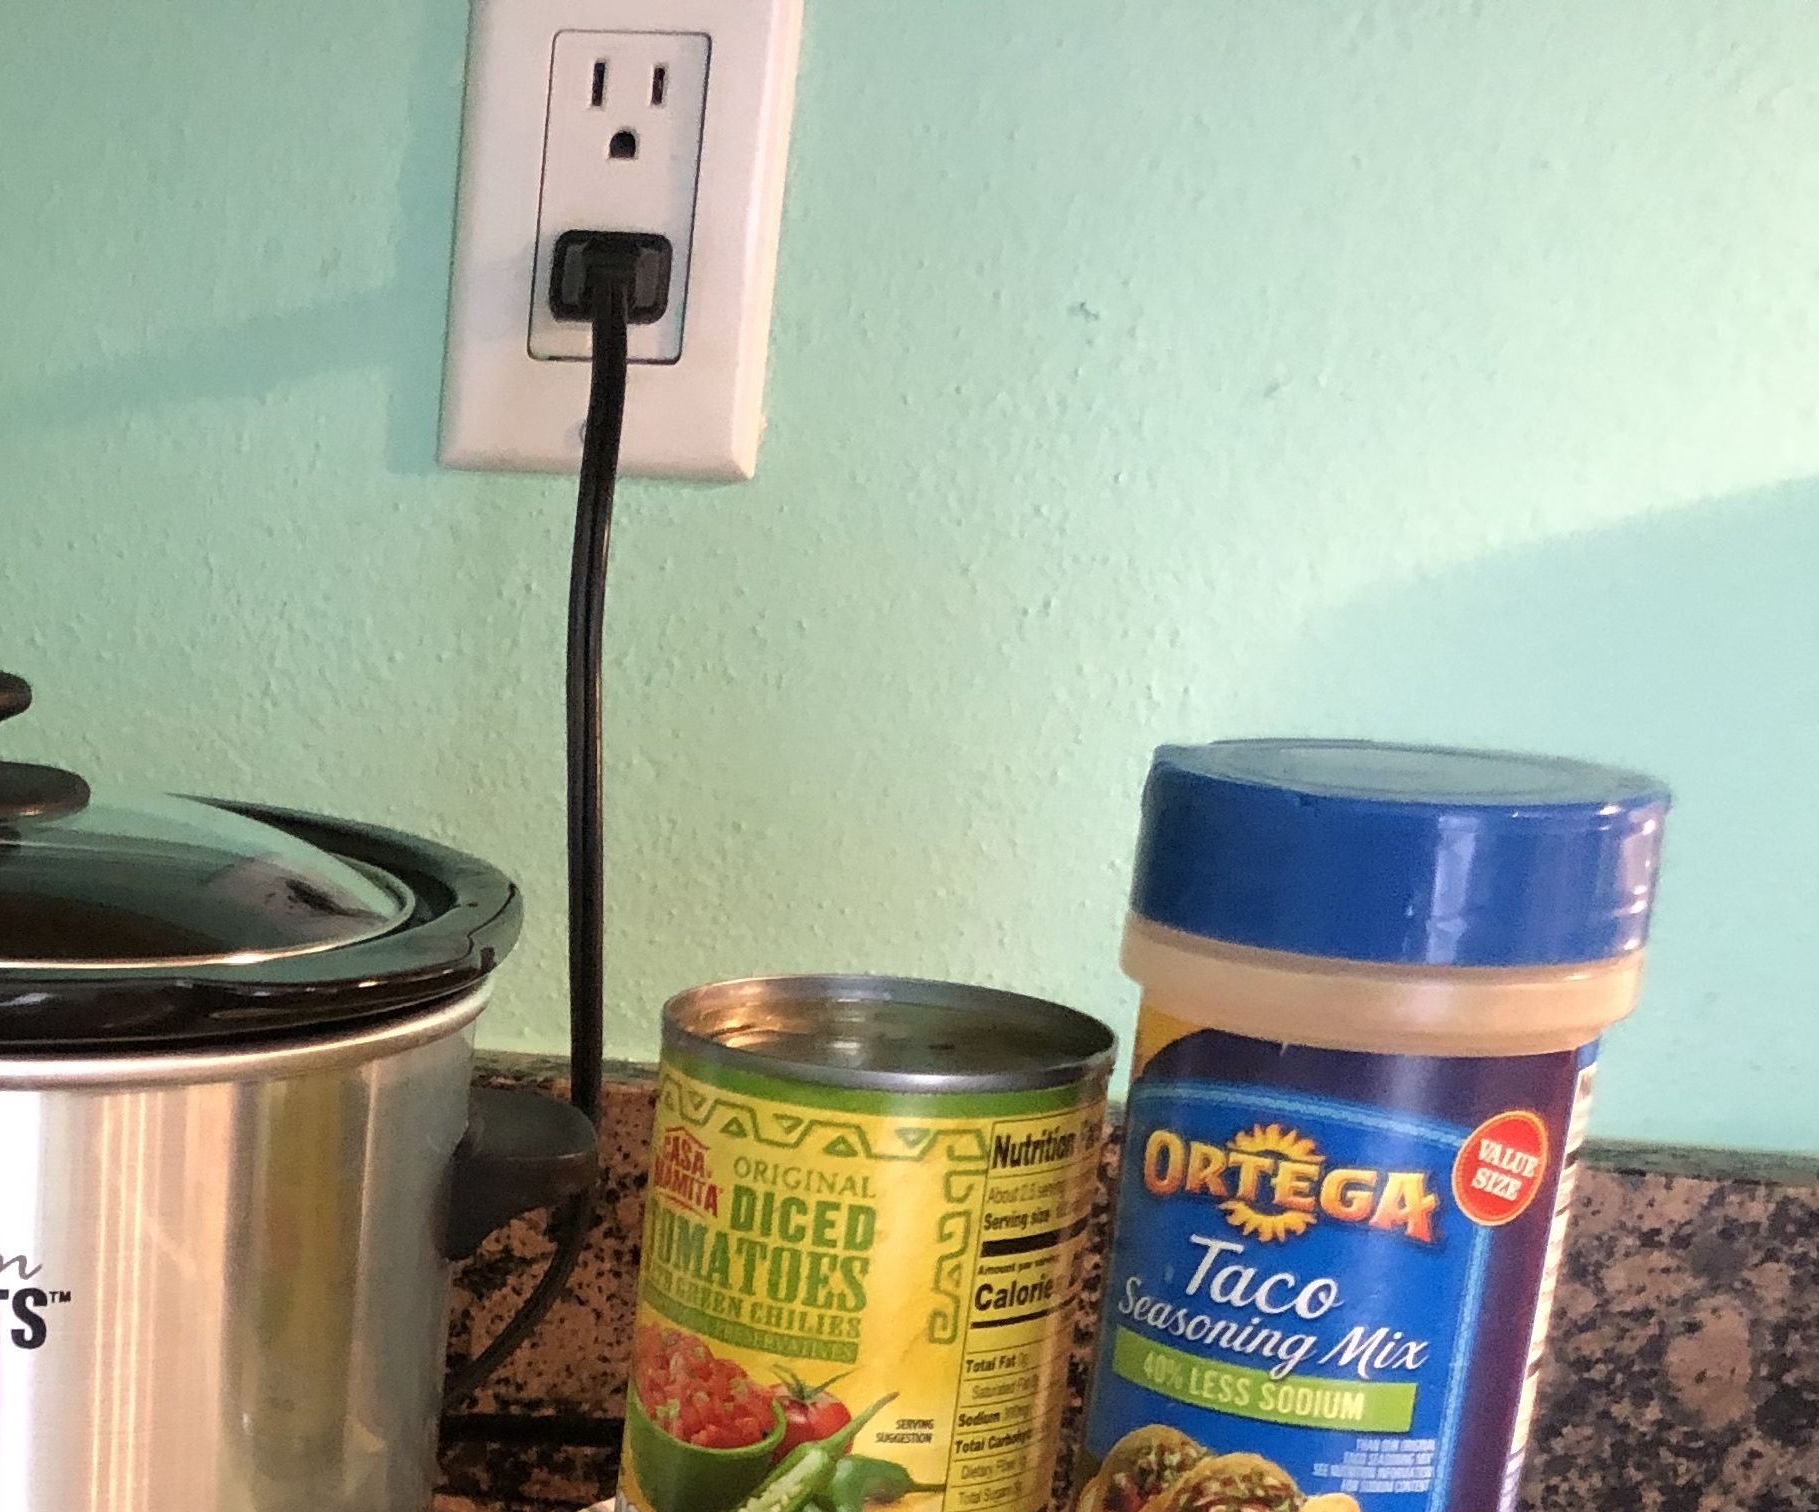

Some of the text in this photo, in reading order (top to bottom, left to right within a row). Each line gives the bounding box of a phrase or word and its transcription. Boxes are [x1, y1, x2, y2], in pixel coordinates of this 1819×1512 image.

[992, 1125, 1076, 1170] Nutrition
[1478, 1138, 1540, 1179] VALUE
[733, 1155, 876, 1199] ORIGINAL
[1144, 1127, 1440, 1242] ORTEGA
[1471, 1166, 1523, 1202] SIZE
[730, 1184, 877, 1252] DICED
[1185, 1233, 1344, 1319] Taco
[749, 1301, 862, 1339] CHILIES
[1118, 1276, 1430, 1381] Seasoning Mix
[1144, 1352, 1366, 1421] 40% LESS SODIUM
